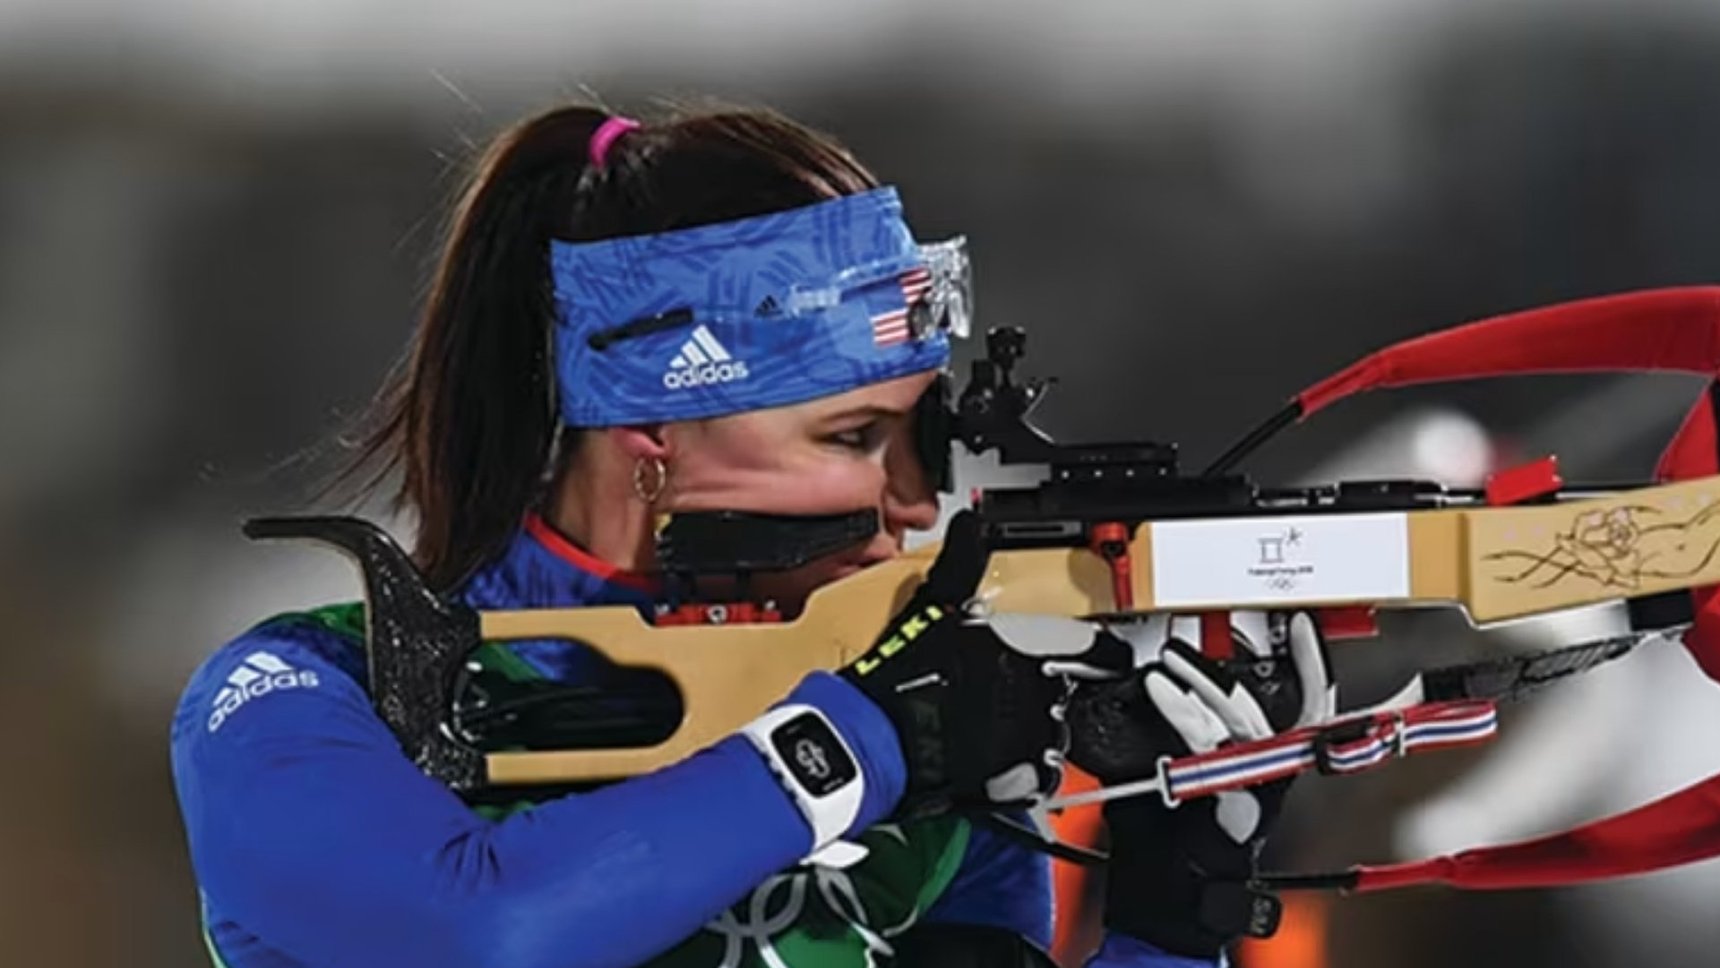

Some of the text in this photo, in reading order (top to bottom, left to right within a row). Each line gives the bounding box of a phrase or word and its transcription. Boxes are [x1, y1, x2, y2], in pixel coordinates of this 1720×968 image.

[663, 361, 749, 390] adidas
[855, 605, 944, 675] LEKI
[207, 670, 320, 733] adidas
